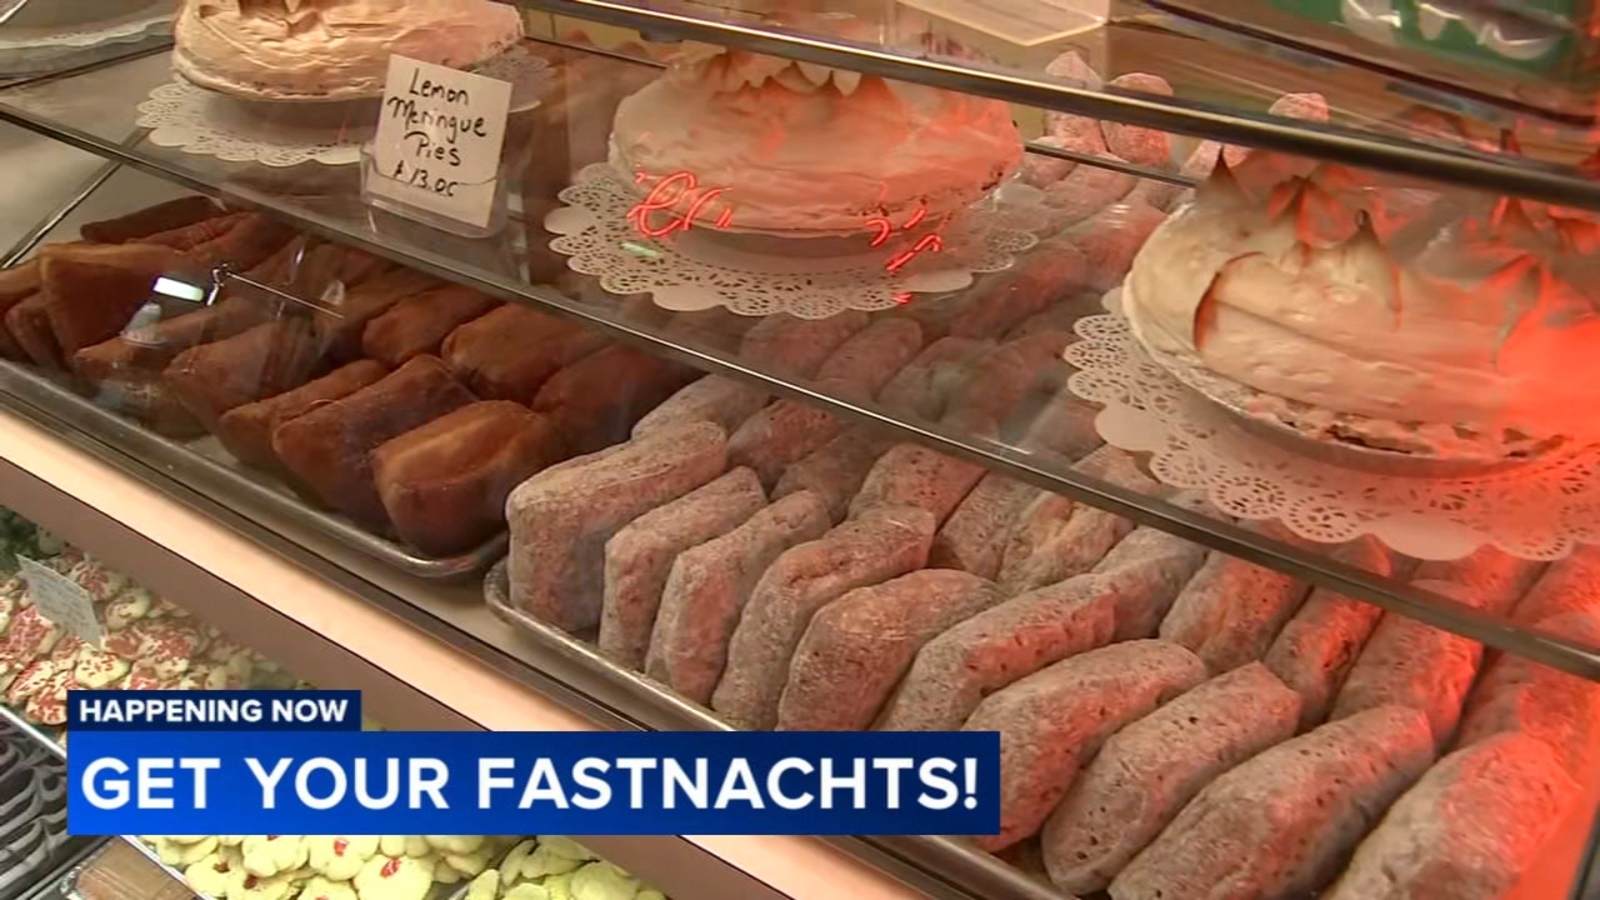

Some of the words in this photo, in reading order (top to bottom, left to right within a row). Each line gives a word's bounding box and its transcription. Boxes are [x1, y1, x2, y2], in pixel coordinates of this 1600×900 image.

[409, 67, 469, 105] Lemon
[386, 96, 487, 144] Meringue
[404, 130, 462, 167] Pies
